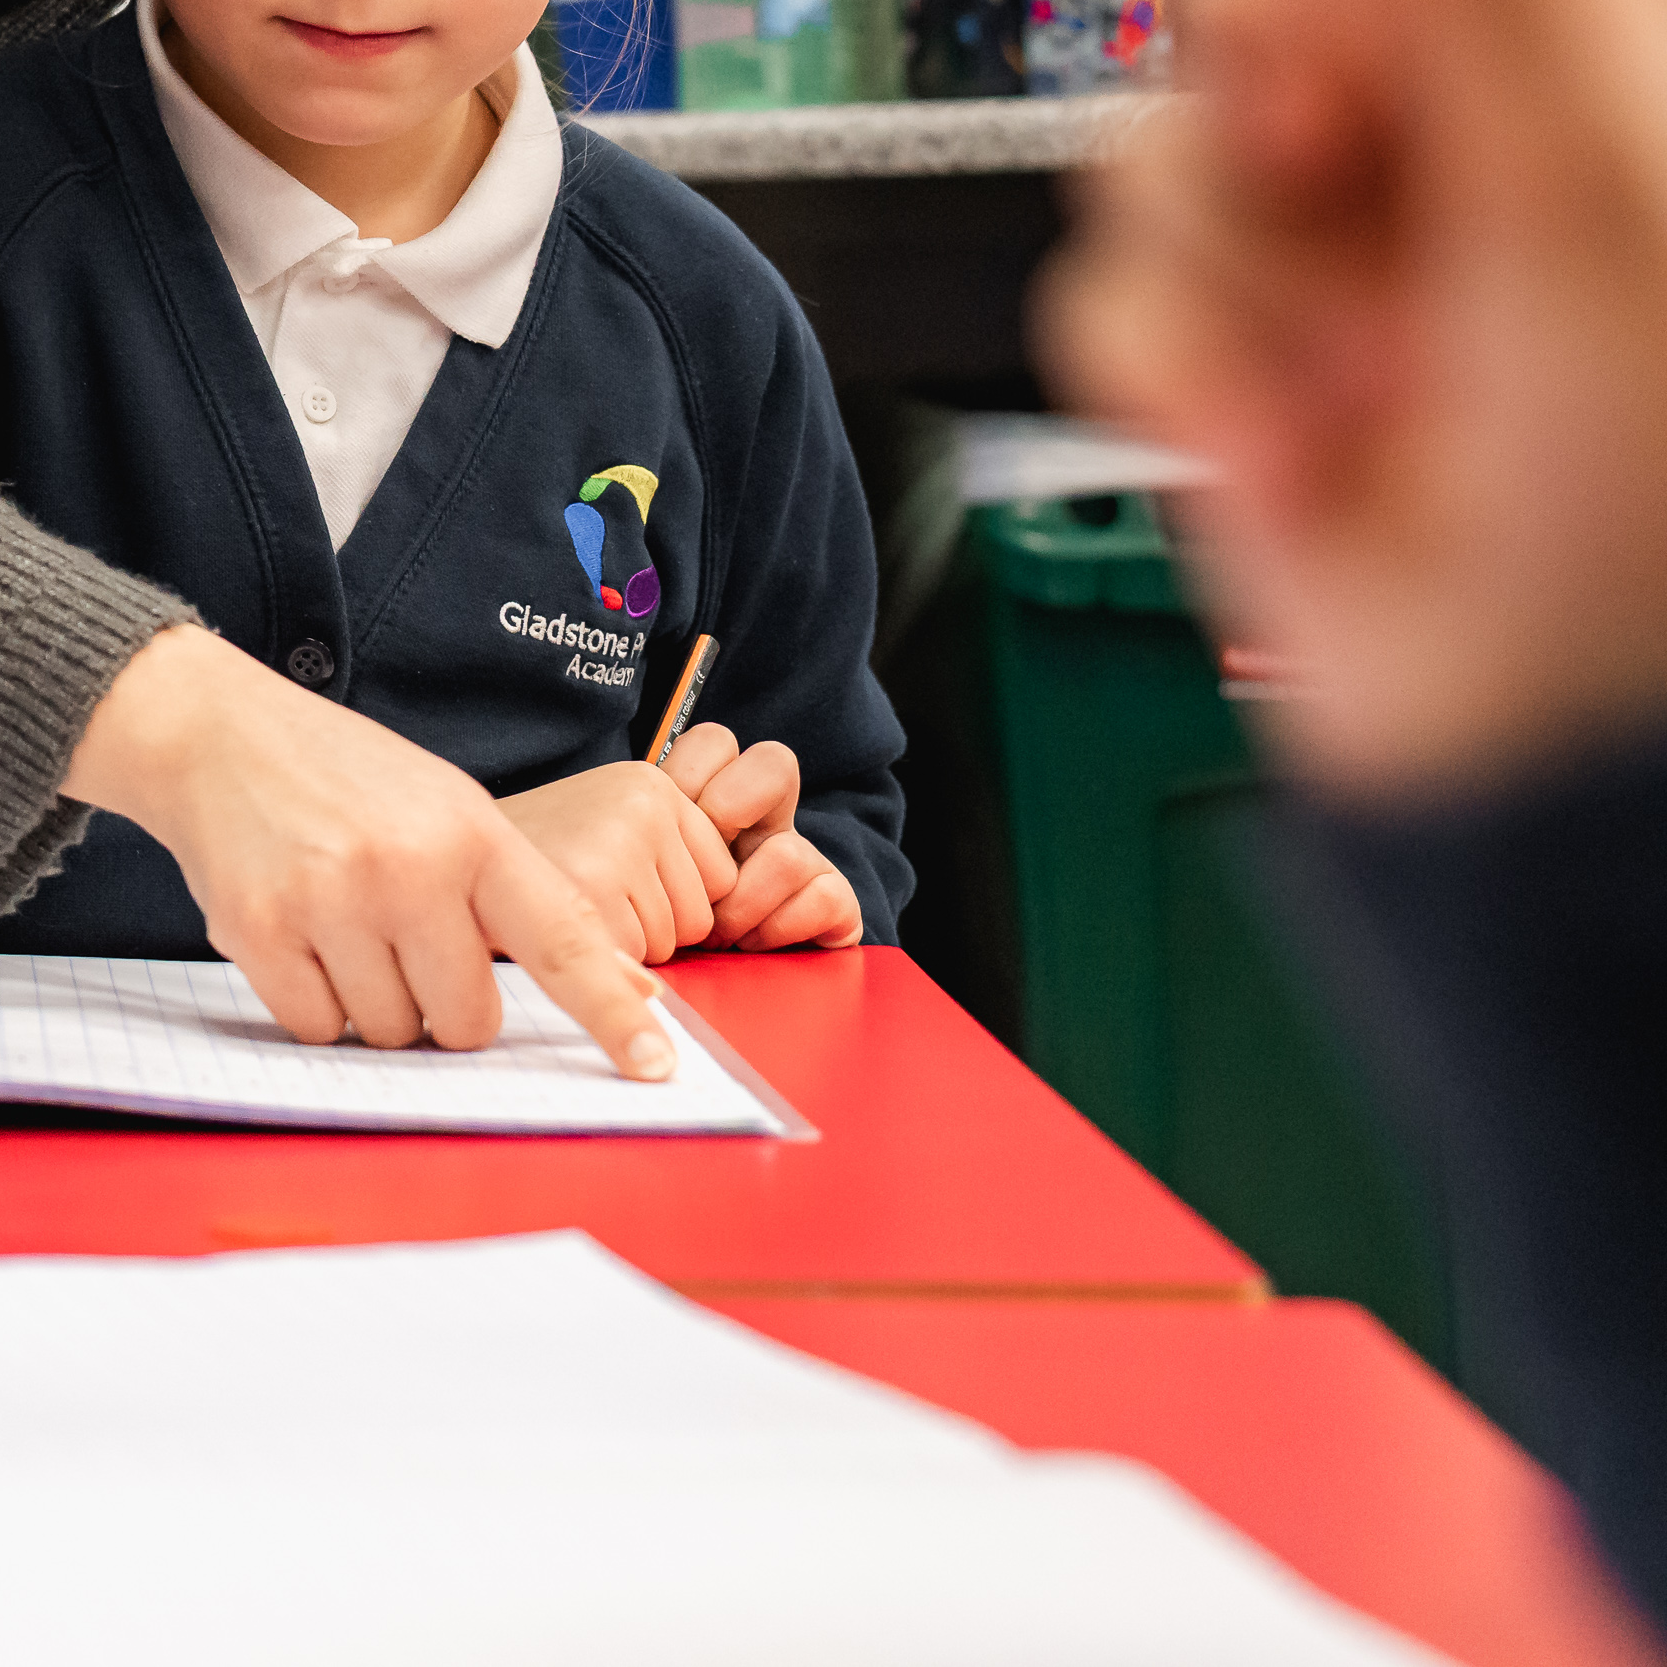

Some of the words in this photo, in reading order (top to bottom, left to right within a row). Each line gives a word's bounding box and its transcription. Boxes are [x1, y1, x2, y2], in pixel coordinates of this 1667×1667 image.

[499, 601, 629, 659] Gladstone
[566, 653, 635, 687] Academ
[672, 714, 686, 736] Noris
[682, 690, 696, 716] colour
